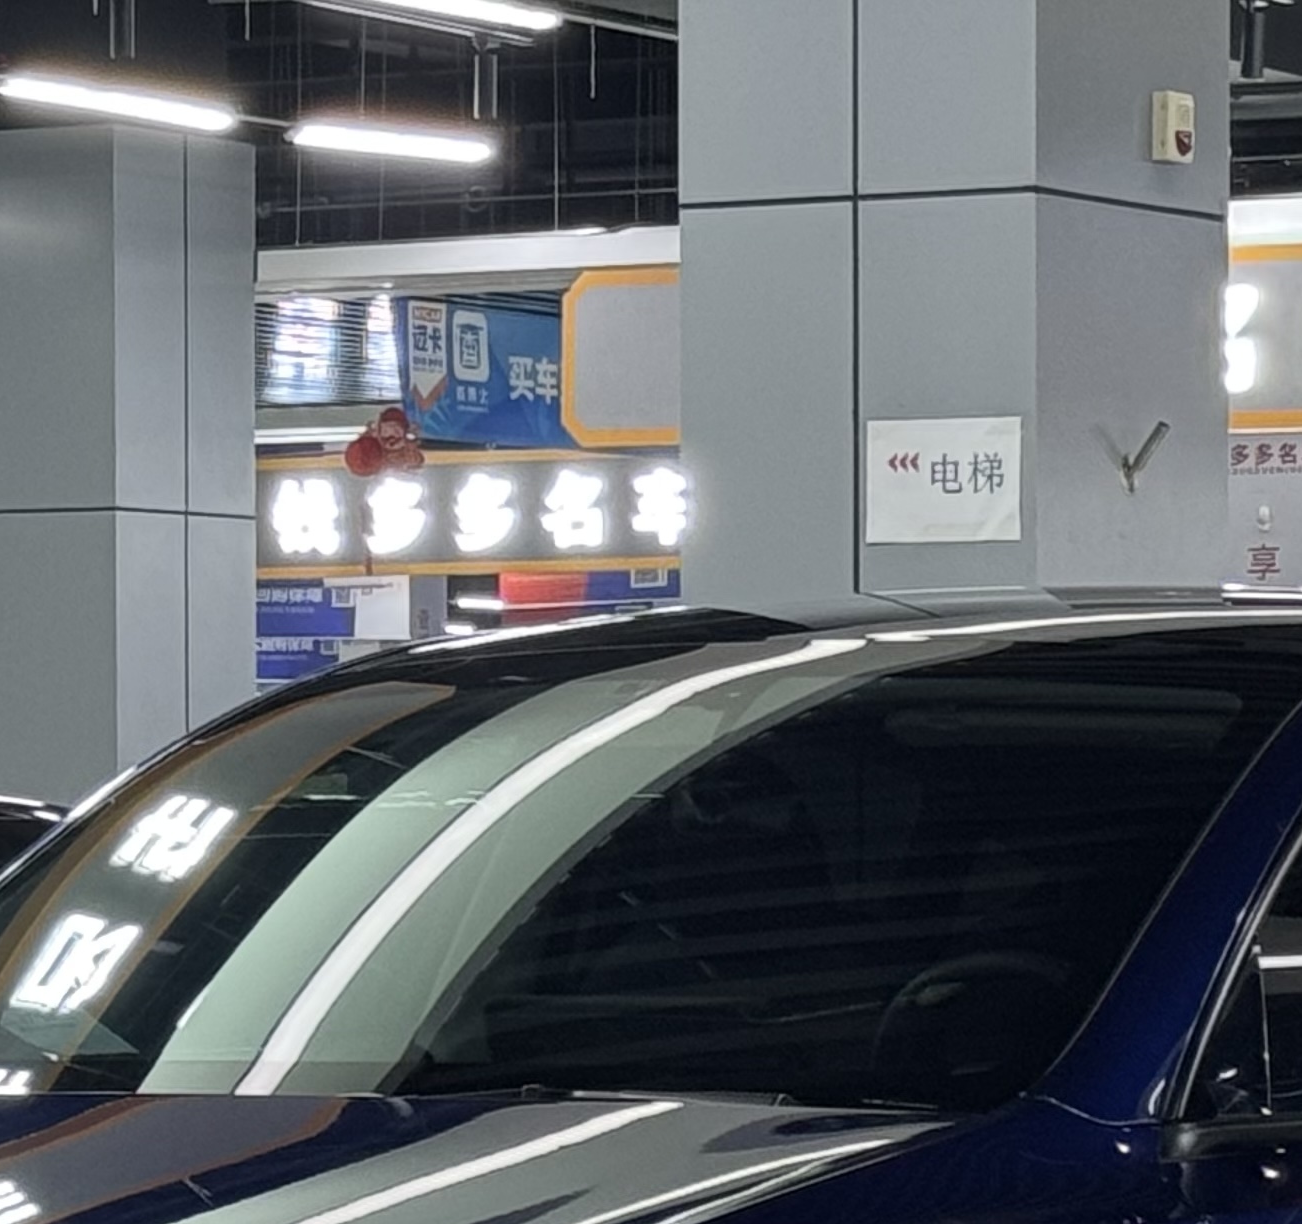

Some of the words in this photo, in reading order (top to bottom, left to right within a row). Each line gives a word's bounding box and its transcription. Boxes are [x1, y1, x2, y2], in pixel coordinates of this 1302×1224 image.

[509, 355, 557, 404] 买车
[929, 452, 1005, 495] 电梯
[272, 466, 687, 554] 钱多多名车
[1246, 543, 1281, 581] 享
